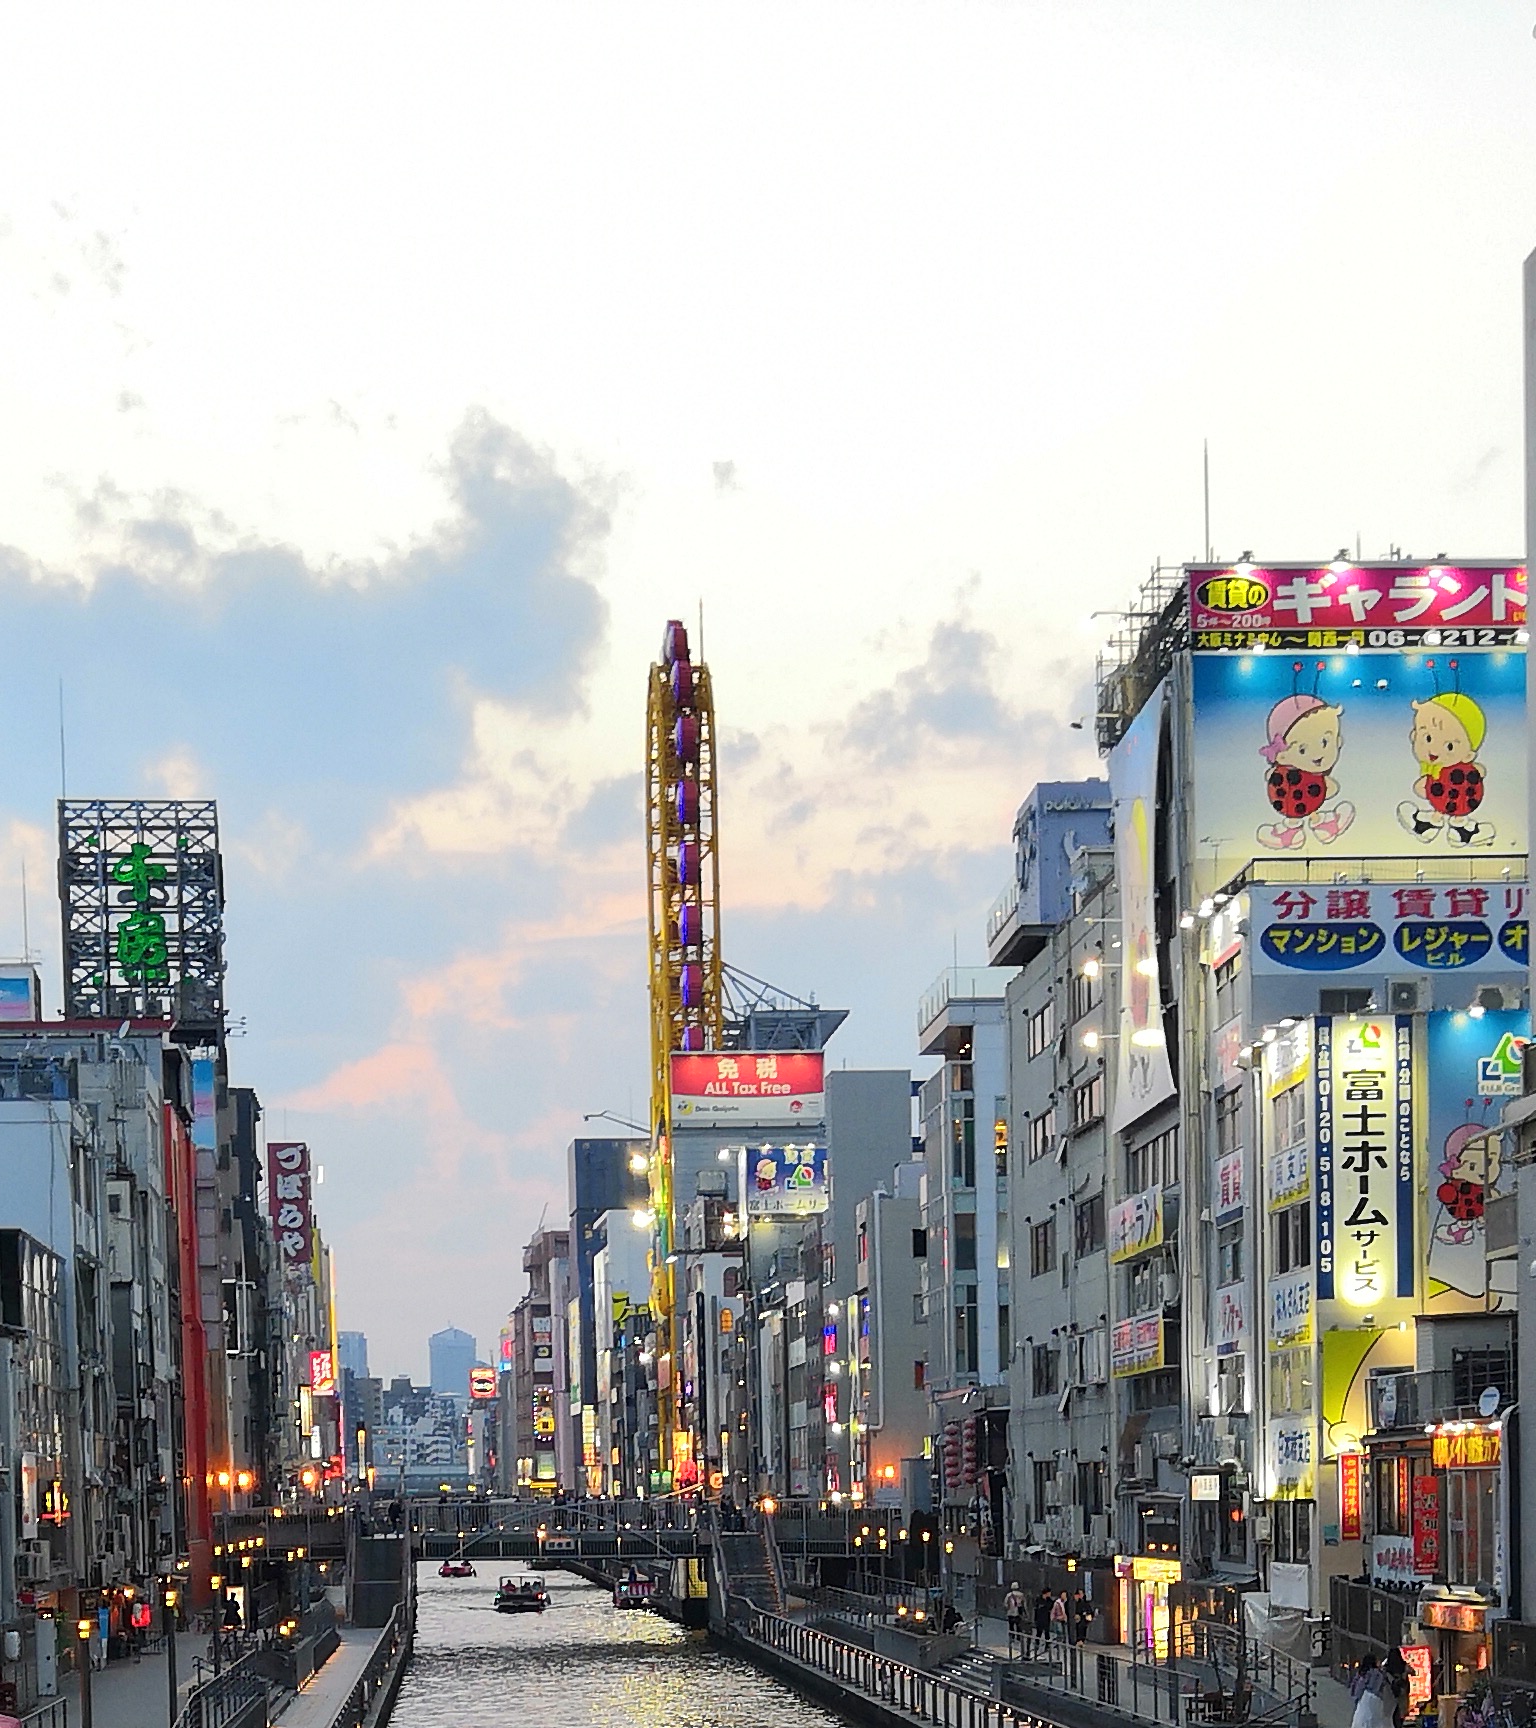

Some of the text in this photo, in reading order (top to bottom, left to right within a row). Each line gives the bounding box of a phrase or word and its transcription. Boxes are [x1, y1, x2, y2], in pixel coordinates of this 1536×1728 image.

[1206, 580, 1266, 609] 賃貸の
[1272, 890, 1372, 920] 分譲
[1392, 888, 1490, 920] 賃貸
[1269, 928, 1380, 955] マンション
[1401, 926, 1489, 953] レジャー
[1426, 951, 1465, 966] ビル
[717, 1057, 778, 1080] 免税
[704, 1082, 792, 1095] ALL Tax Free
[1341, 1069, 1389, 1292] 富士ホームサービス
[275, 1144, 306, 1257] づぼらや
